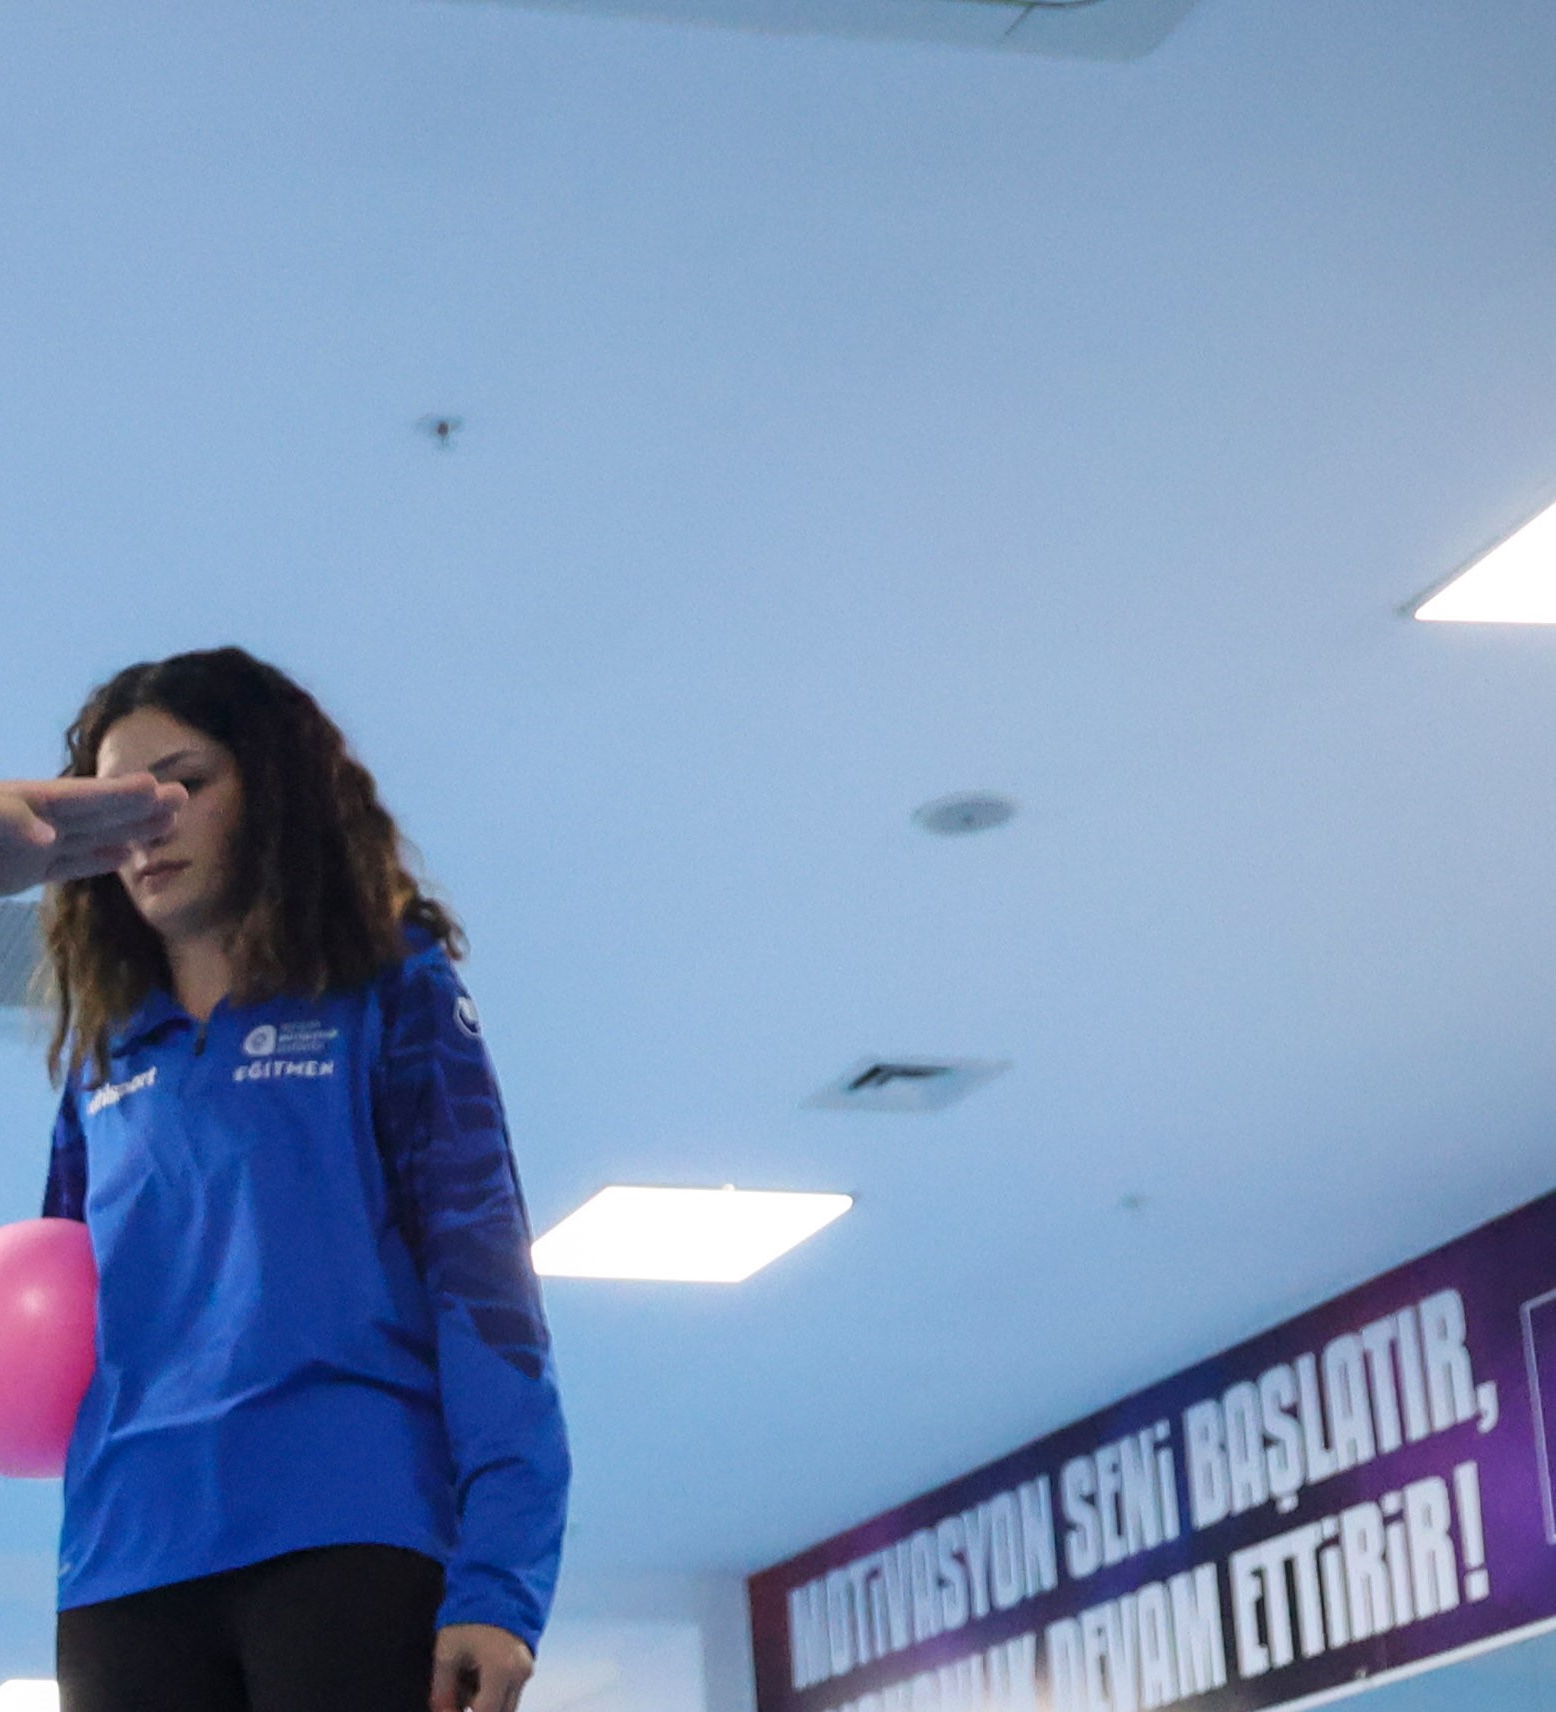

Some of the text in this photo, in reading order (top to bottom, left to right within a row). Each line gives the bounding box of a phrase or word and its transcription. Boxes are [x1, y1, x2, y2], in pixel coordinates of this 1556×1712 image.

[1060, 1418, 1181, 1580] SENİ
[1183, 1288, 1500, 1532] BAŞLATIR,
[1229, 1460, 1489, 1680] ETTİRİR!
